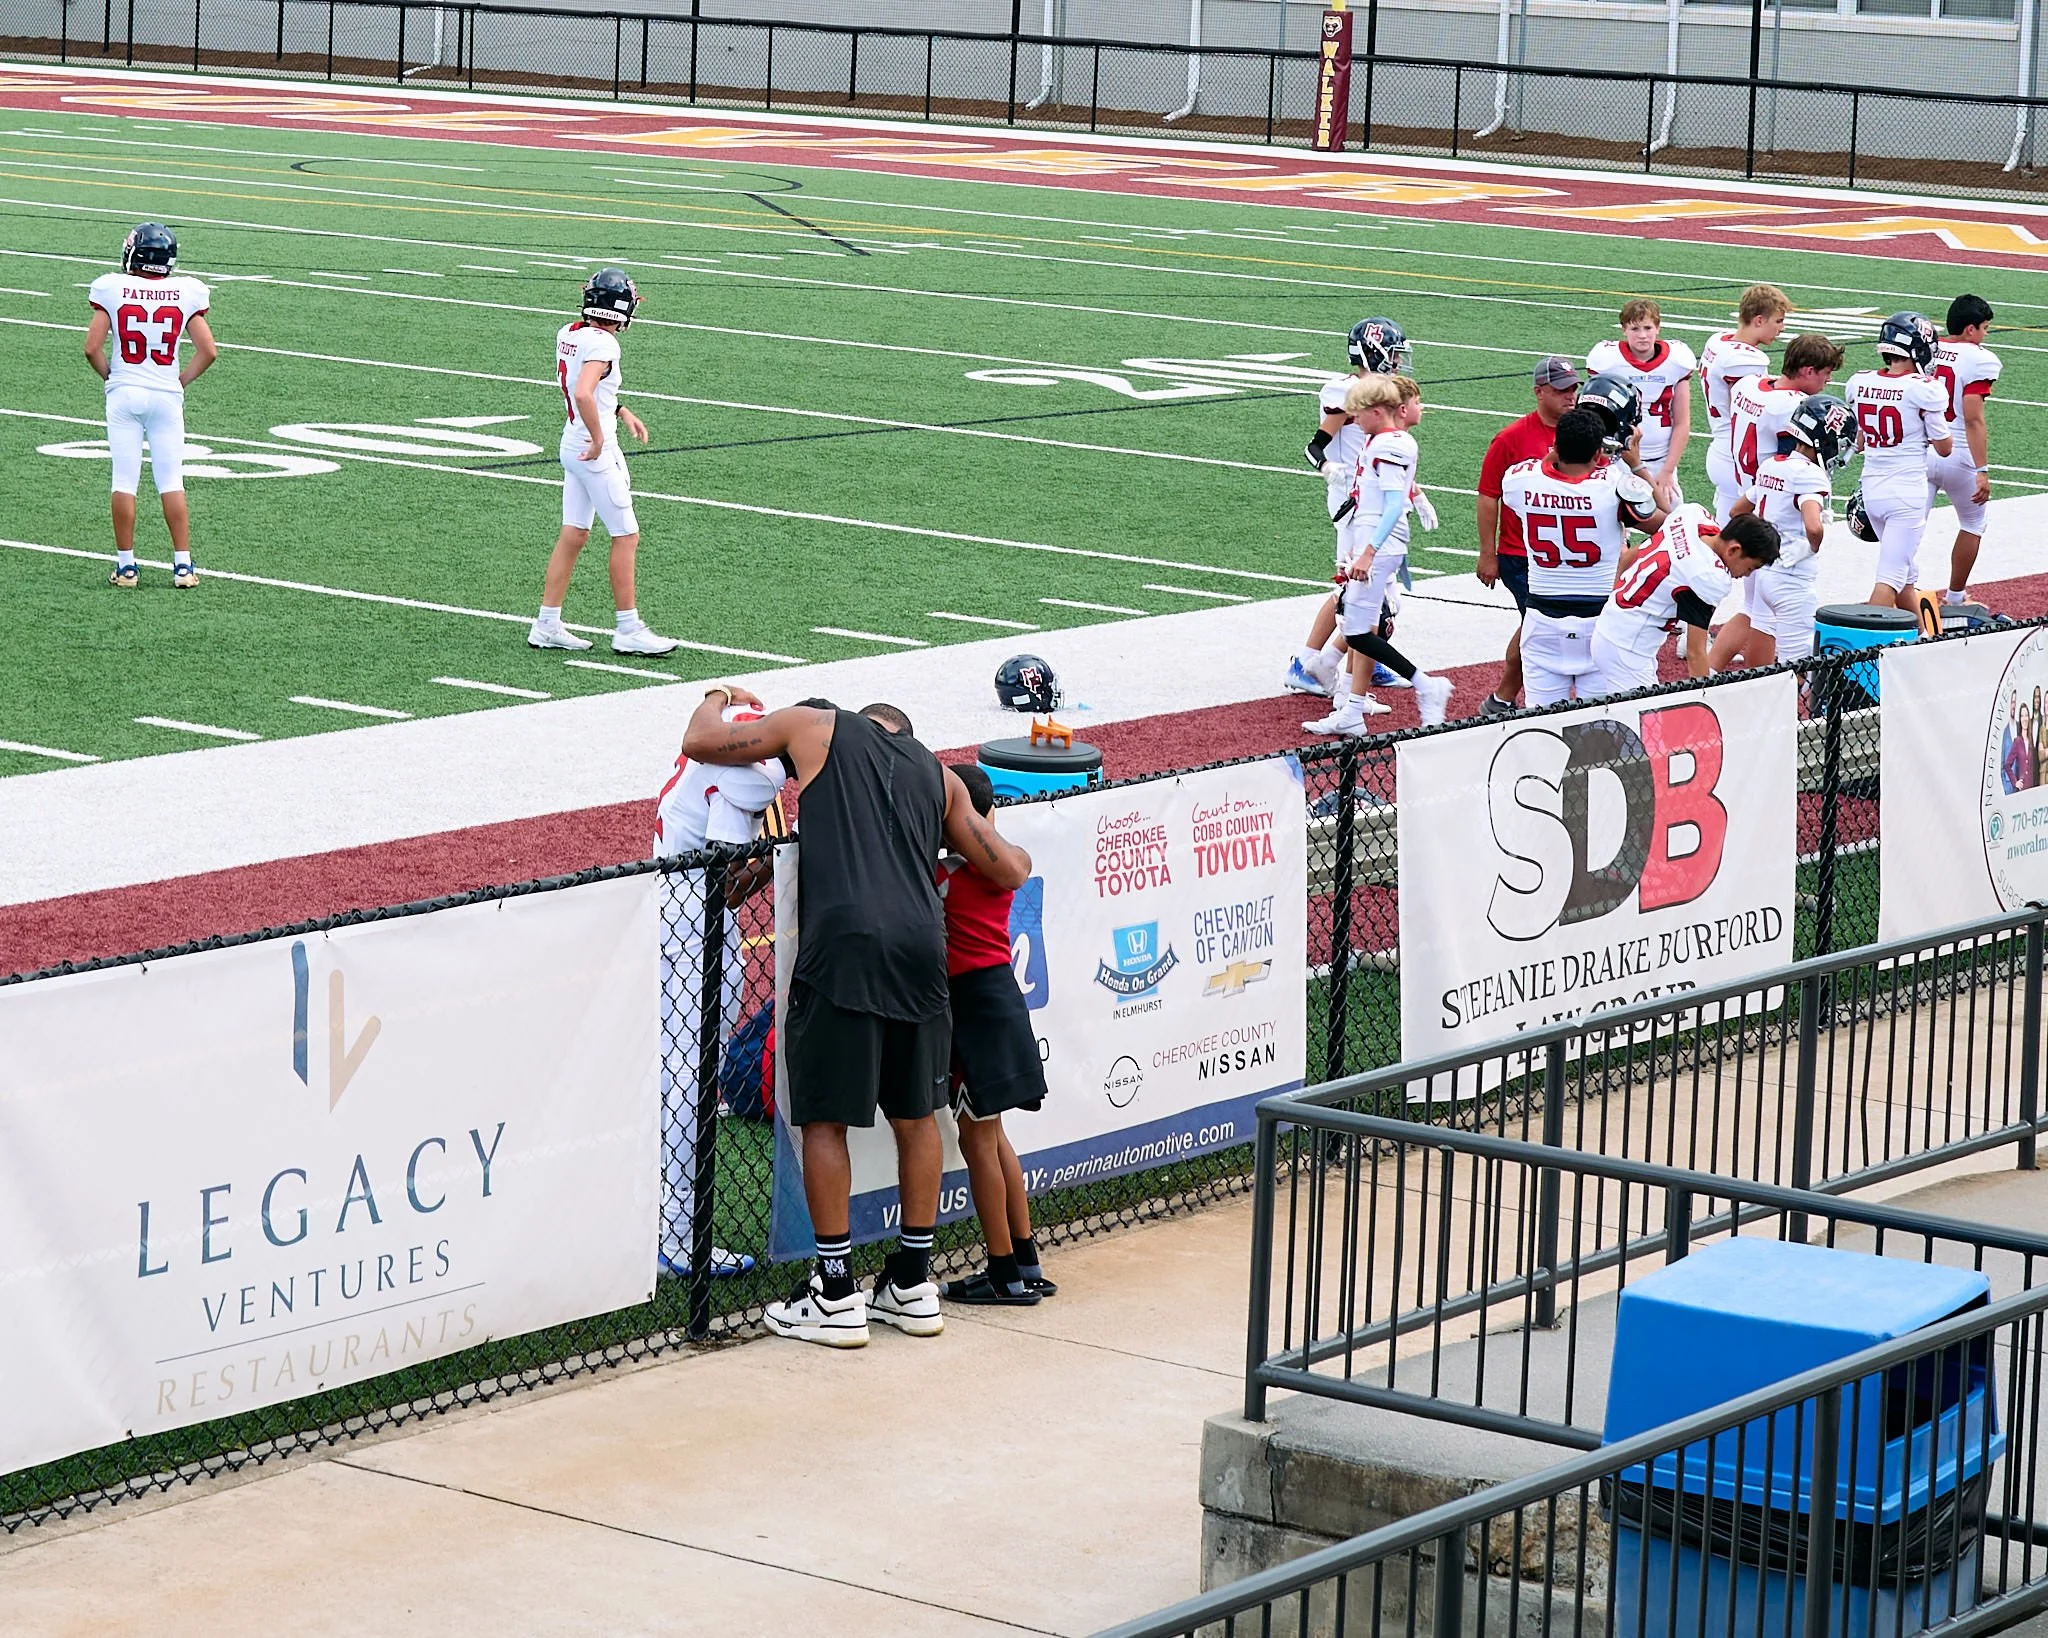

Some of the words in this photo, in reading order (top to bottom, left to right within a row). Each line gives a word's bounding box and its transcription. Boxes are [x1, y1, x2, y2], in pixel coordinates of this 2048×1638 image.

[1317, 41, 1340, 147] WALKER
[123, 288, 180, 301] PATRIOTS
[117, 304, 184, 366] 63
[1733, 391, 1766, 417] PATRIOTS
[1857, 386, 1904, 401] PATRIOTS
[1857, 403, 1904, 448] 50
[36, 423, 545, 479] 30
[1524, 490, 1593, 511] PATRIOTS
[1526, 512, 1602, 569] 55
[1192, 791, 1229, 824] Count
[1193, 822, 1222, 844] COBB
[1226, 812, 1274, 836] COUNTY
[1486, 701, 1729, 942] SDB
[1095, 842, 1168, 874] COUNTY
[1096, 825, 1167, 852] CHEROKEE
[1194, 833, 1276, 878] TOYOTA
[1094, 864, 1171, 898] TOYOTA
[1194, 896, 1274, 937] CHEVROLET
[1123, 953, 1153, 967] HONDA
[1196, 937, 1216, 964] OF
[1222, 922, 1274, 959] CANTON
[1100, 967, 1130, 992] Honda
[1132, 976, 1146, 991] On
[1147, 953, 1174, 985] Grand
[1441, 954, 1556, 1030] STEFANIE
[1562, 937, 1651, 993] DRAKE
[1657, 906, 1784, 970] BURFORD
[1113, 1009, 1121, 1020] IN
[1122, 999, 1163, 1018] ELMHURST
[1152, 1034, 1218, 1068] CHEROKEE
[1222, 1020, 1278, 1048] COUNTY
[1198, 1042, 1277, 1081] NISSAN
[1103, 1073, 1144, 1091] NISSAN
[940, 1186, 968, 1213] US
[1050, 1119, 1235, 1188] perrinautomotive.com
[137, 1121, 506, 1279] LEGACY
[201, 1238, 450, 1333] VENTURES
[156, 1302, 478, 1416] RESTAURANTS
